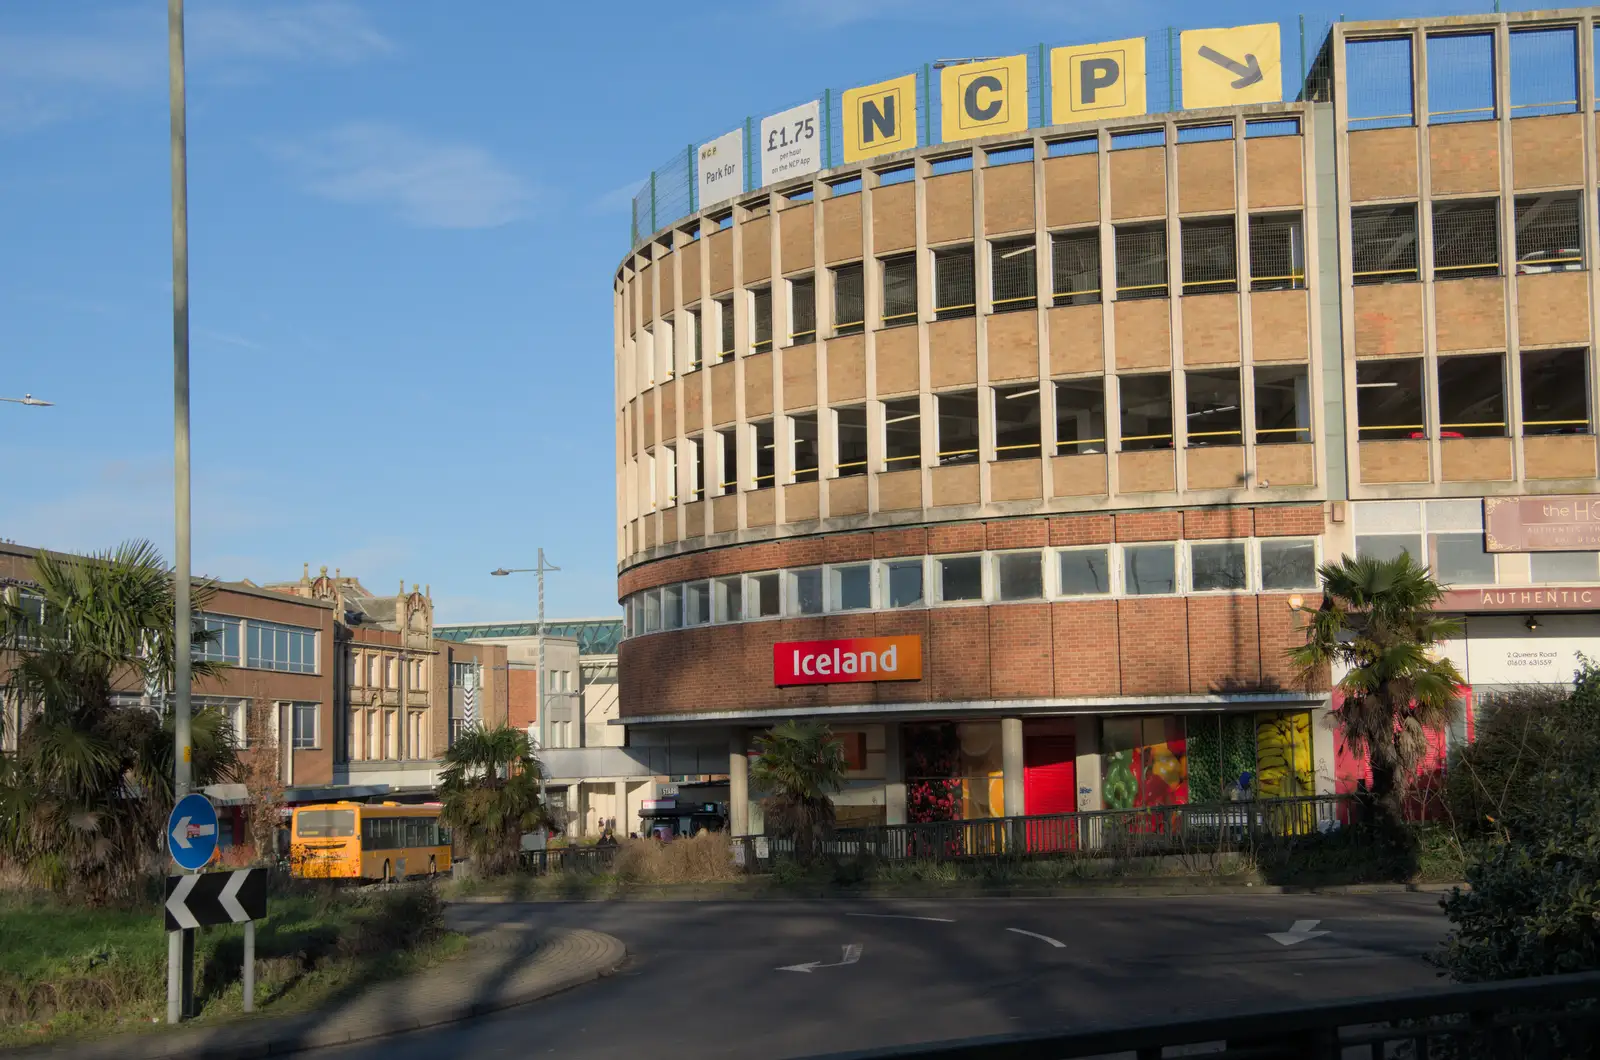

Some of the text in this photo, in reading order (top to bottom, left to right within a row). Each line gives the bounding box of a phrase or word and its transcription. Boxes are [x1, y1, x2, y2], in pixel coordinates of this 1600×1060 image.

[862, 57, 1120, 143] N C P
[767, 117, 814, 152] £1.75
[780, 148, 802, 161] per hour
[779, 163, 788, 172] the
[789, 159, 800, 169] NCP
[706, 163, 735, 184] Park for
[1543, 504, 1569, 516] the
[1527, 526, 1582, 534] AUTHENTIC
[1483, 591, 1592, 605] AUTHENTIC
[793, 644, 897, 676] Iceland
